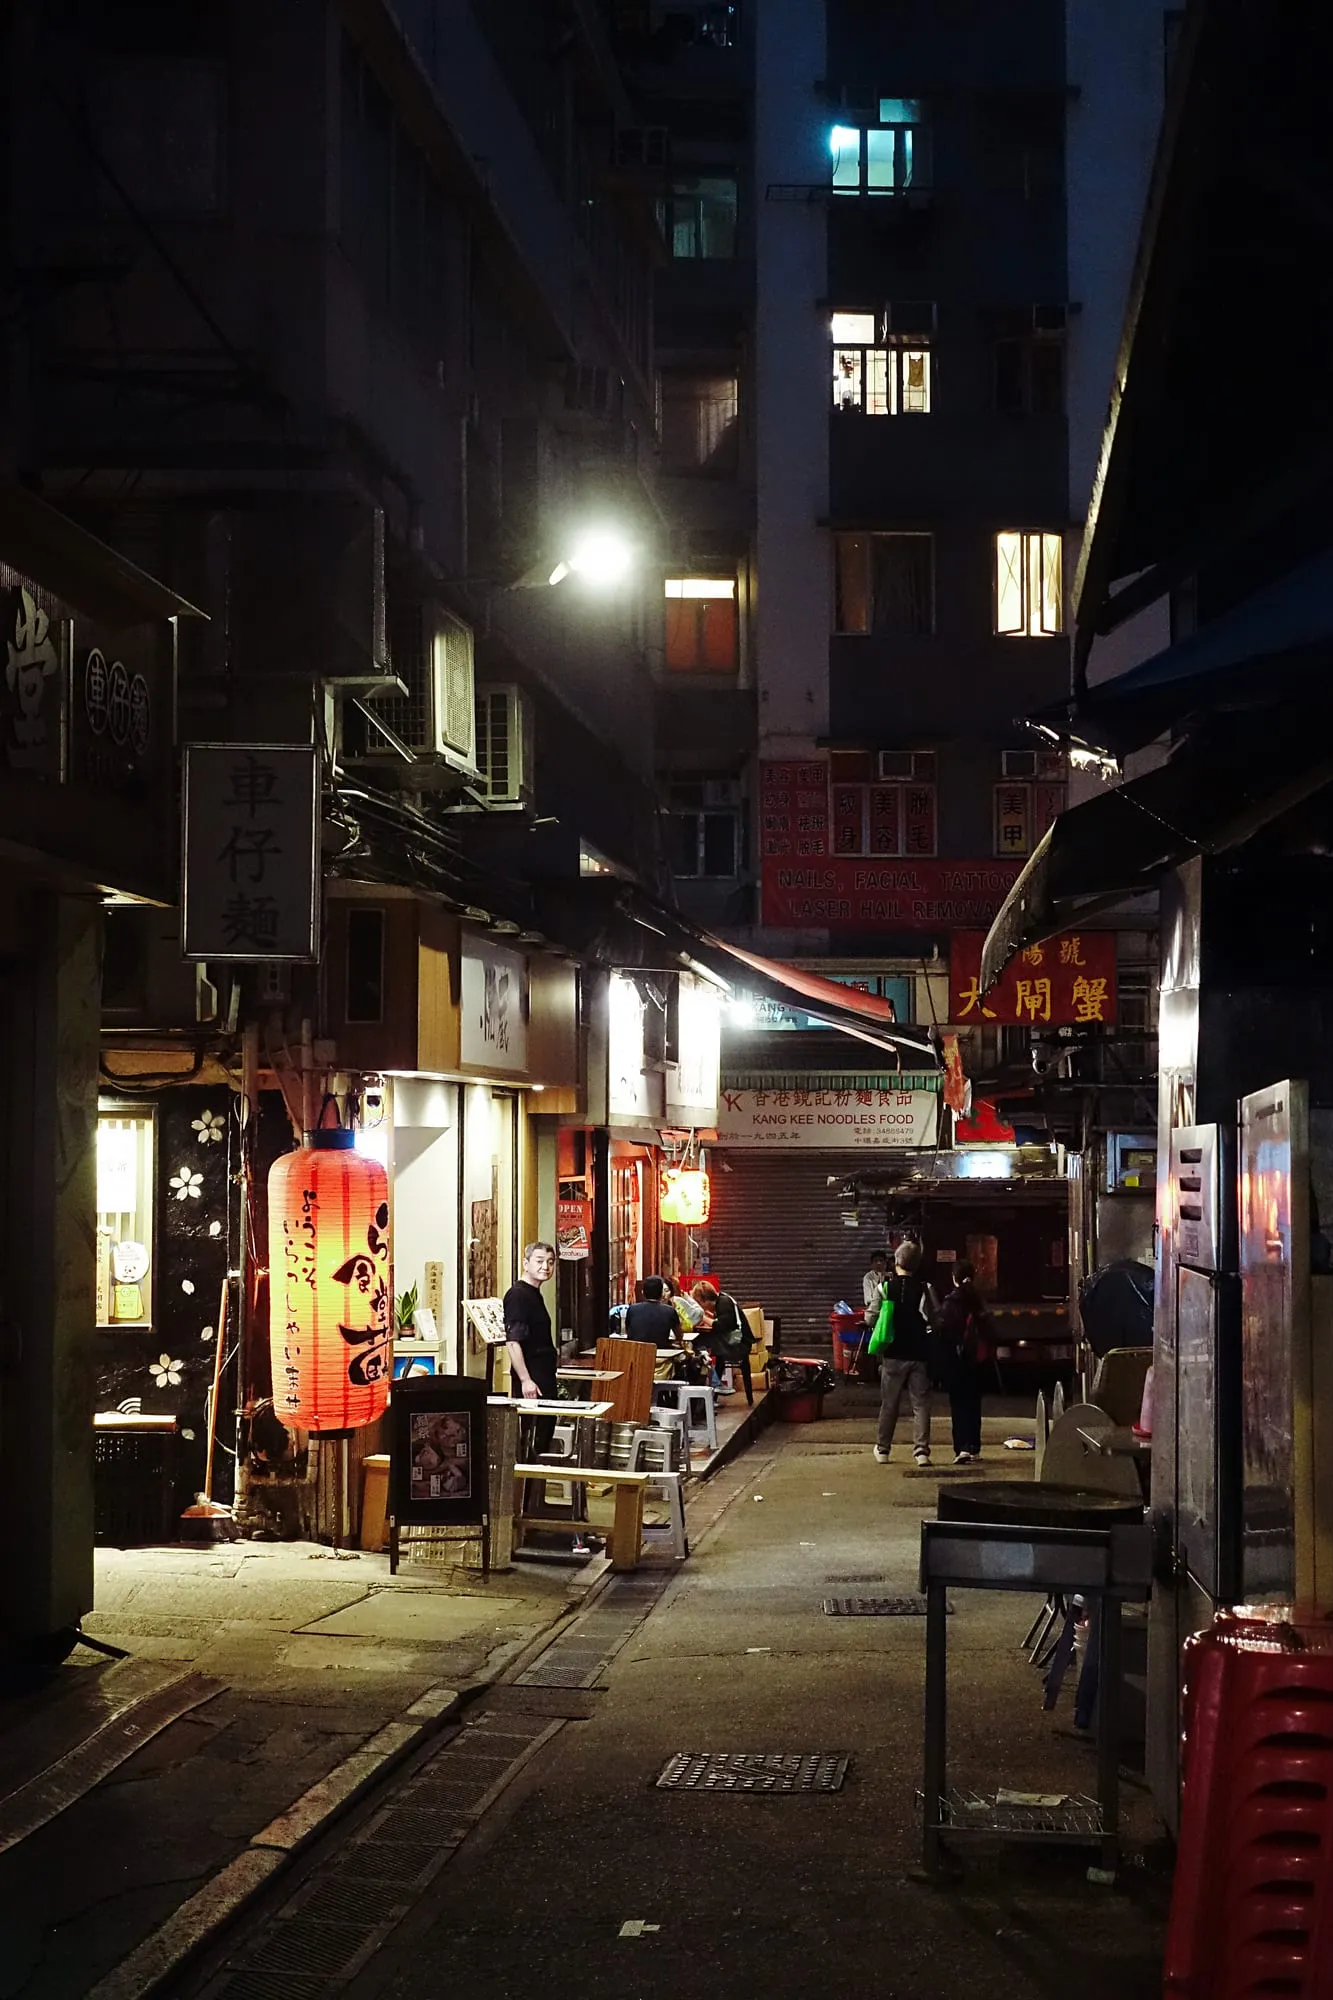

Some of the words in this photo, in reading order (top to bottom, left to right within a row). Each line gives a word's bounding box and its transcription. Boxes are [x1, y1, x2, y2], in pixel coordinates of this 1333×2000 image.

[876, 791, 893, 849] 美容
[1003, 794, 1024, 847] 美甲
[789, 899, 850, 919] LASER
[861, 900, 904, 920] HAIL
[912, 900, 1000, 920] REMOVA
[956, 974, 1110, 1024] 大閘蟹
[752, 1114, 787, 1124] KANG
[790, 1114, 814, 1124] KEE
[817, 1114, 876, 1124] NOODLES
[879, 1114, 914, 1124] FOOD
